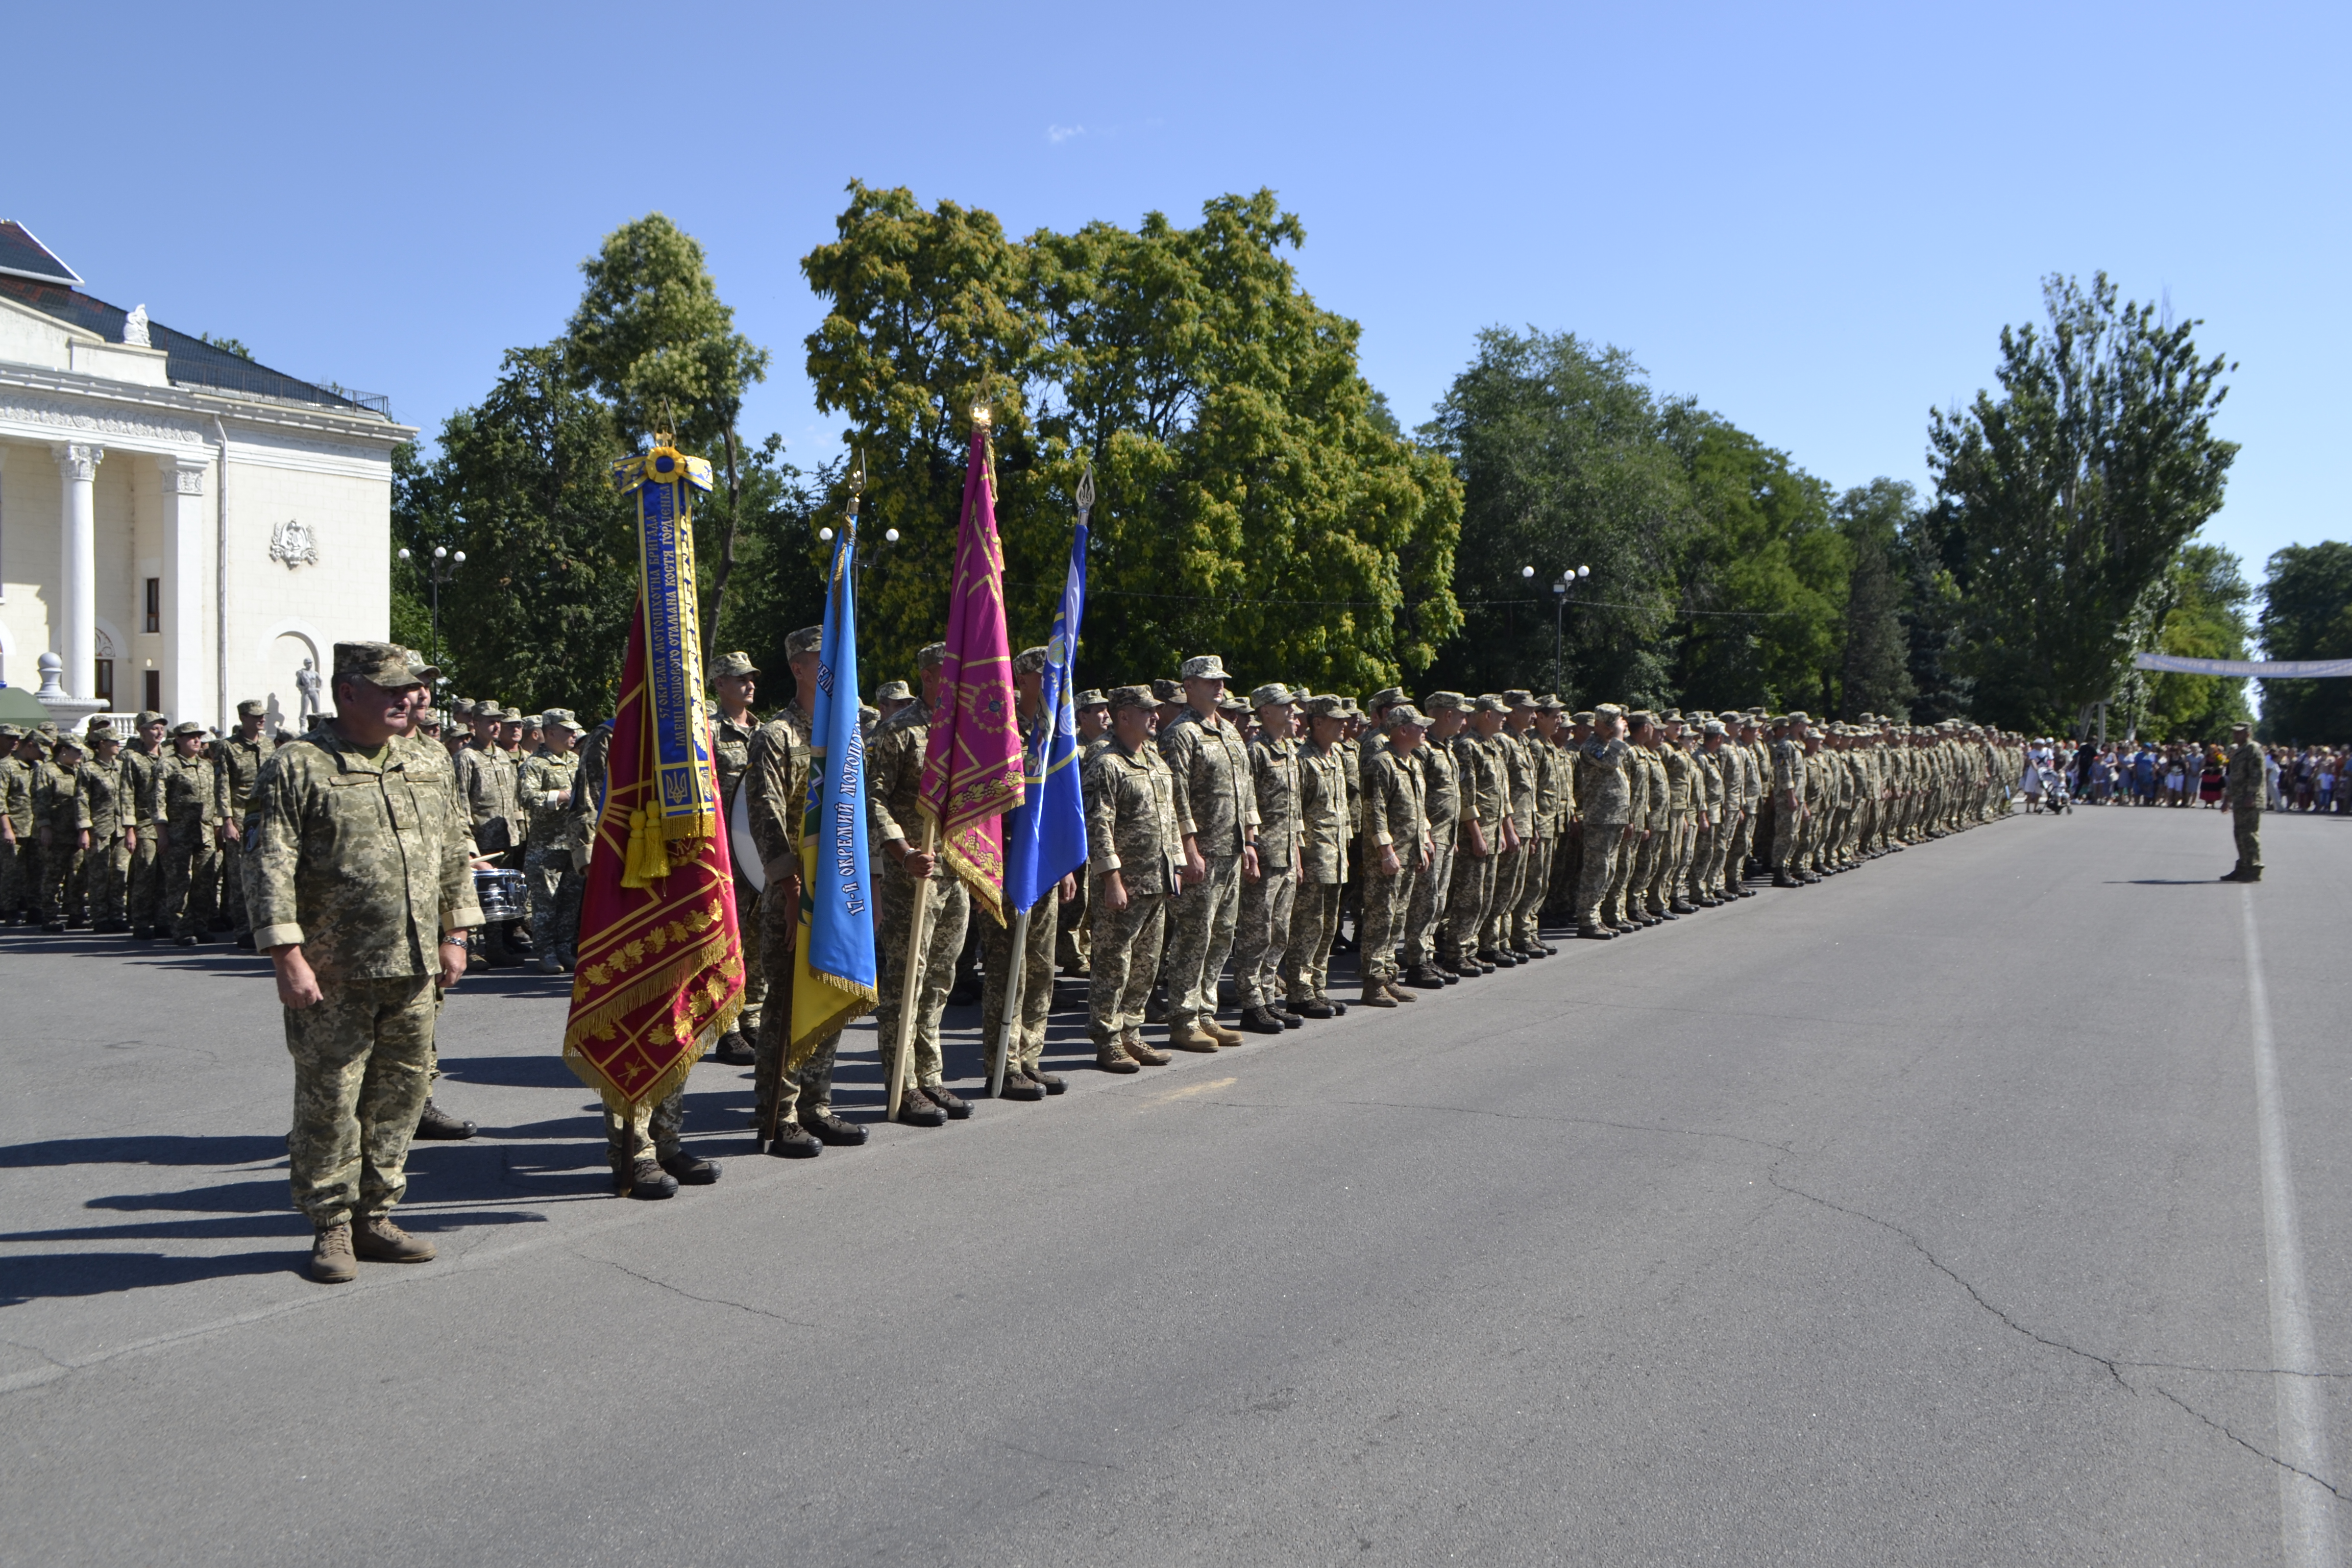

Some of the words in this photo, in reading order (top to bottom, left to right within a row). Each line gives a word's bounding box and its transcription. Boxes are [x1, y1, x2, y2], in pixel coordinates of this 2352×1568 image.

[646, 514, 660, 565] БРИГАДА
[663, 550, 676, 586] КОСТЯ
[649, 569, 665, 652] МОТОПІХОТНА
[666, 591, 680, 646] ОТАМАНА
[655, 657, 669, 705] ОКРЕМА
[669, 650, 683, 707] КОШОВОГО
[660, 708, 670, 718] 57
[673, 710, 686, 746] ІМЕНІ
[835, 802, 855, 876] ОКРЕМИЙ
[842, 881, 865, 916] 17-Й
